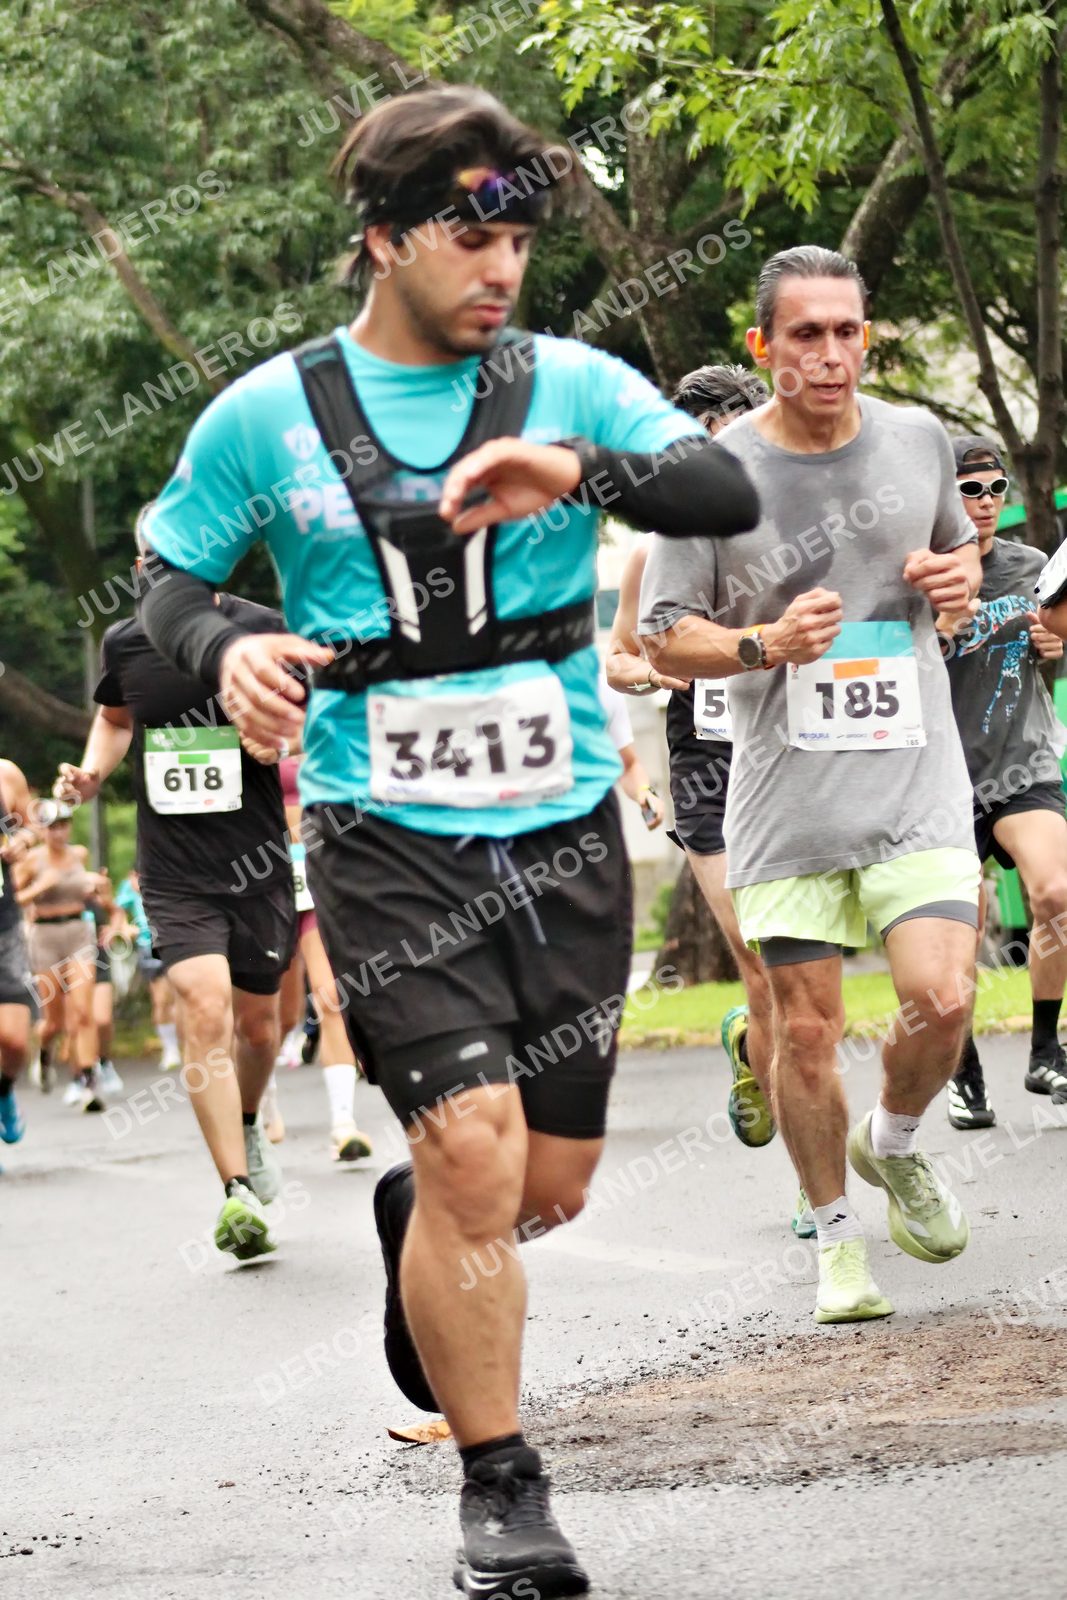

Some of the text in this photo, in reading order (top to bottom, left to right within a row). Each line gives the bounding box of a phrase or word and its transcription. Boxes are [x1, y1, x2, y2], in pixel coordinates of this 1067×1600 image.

[702, 689, 733, 719] 5
[815, 680, 899, 719] 185
[385, 713, 556, 781] 3413
[164, 766, 224, 792] 618
